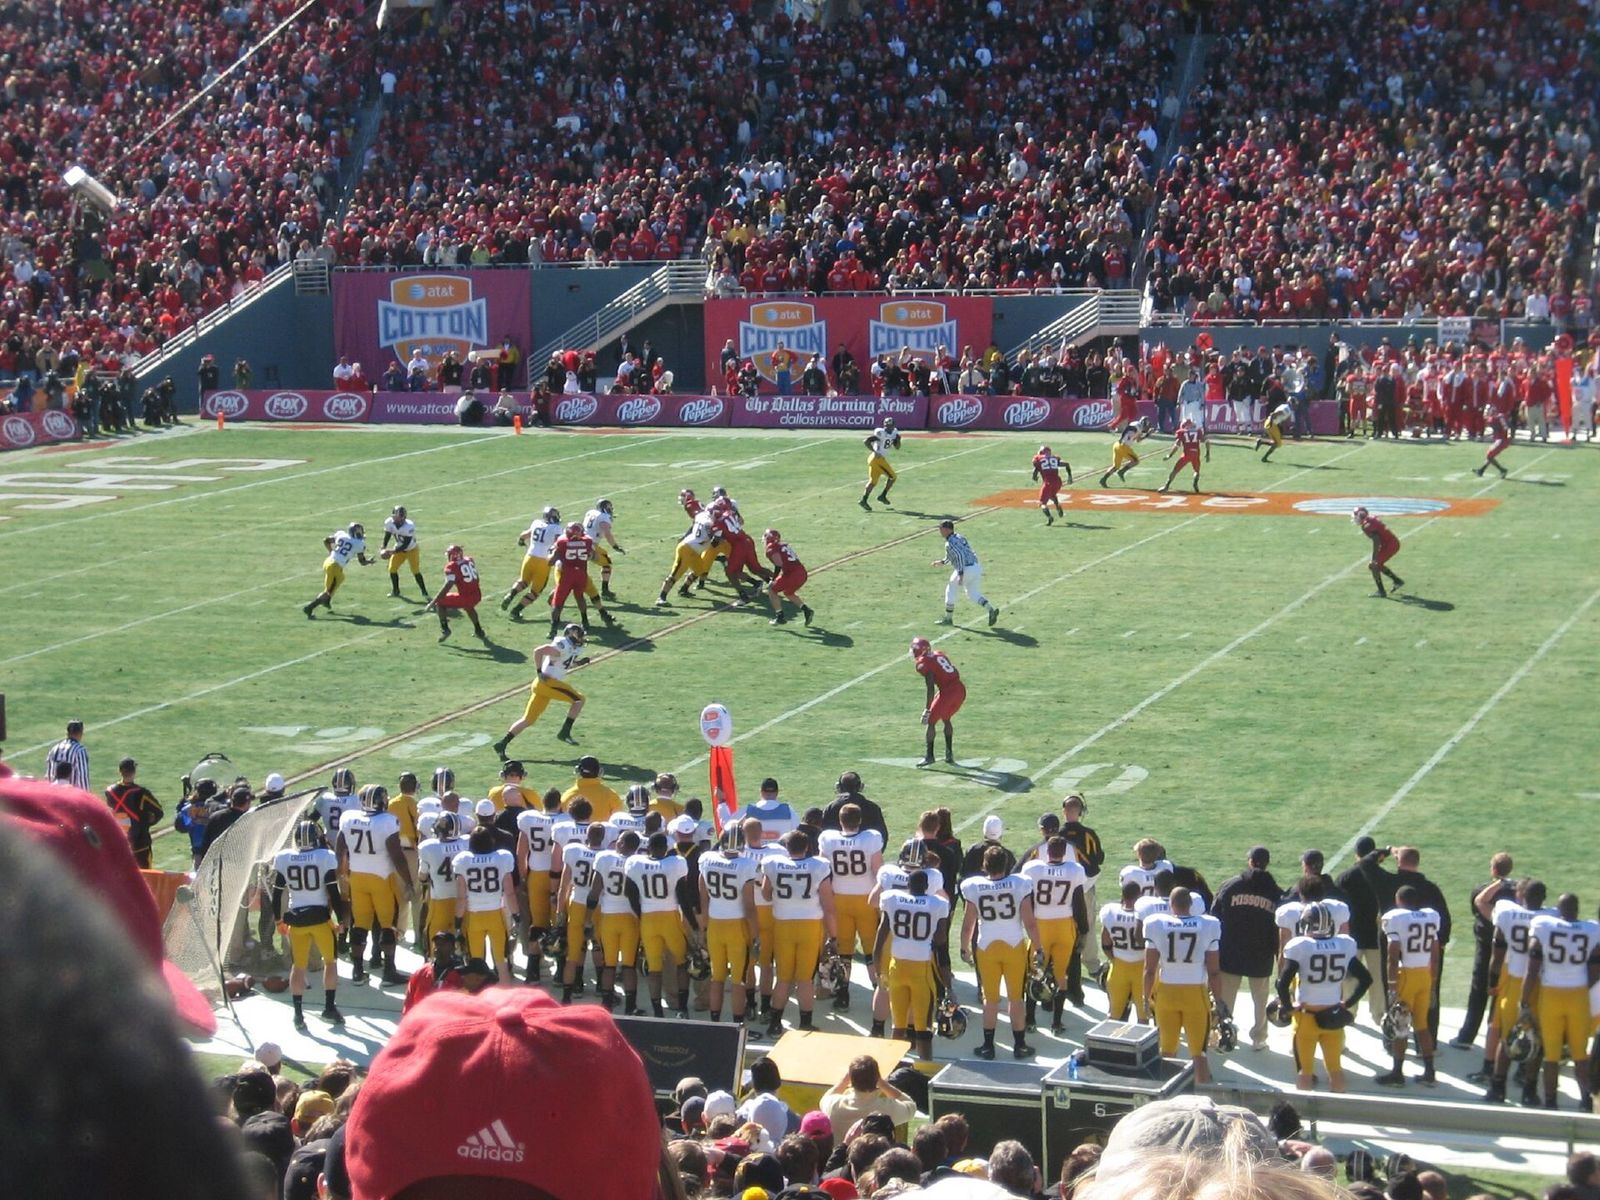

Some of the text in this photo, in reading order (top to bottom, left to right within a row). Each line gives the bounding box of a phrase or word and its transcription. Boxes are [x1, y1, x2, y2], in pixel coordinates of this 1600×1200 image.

[427, 284, 455, 298] at&t
[383, 301, 482, 341] COTTON
[780, 310, 801, 320] at&t
[909, 309, 932, 320] at&t
[743, 324, 824, 355] COTTON
[873, 323, 954, 355] COTTON
[214, 396, 240, 409] FOX
[272, 397, 299, 410] FOX
[332, 398, 357, 410] FOX
[559, 400, 593, 420] Pepper
[571, 397, 586, 410] Dr
[622, 401, 657, 421] Pepper
[632, 398, 649, 410] Dr
[684, 402, 720, 422] Pepper
[694, 398, 711, 411] Dr
[745, 397, 916, 414] The Dallas Morning News
[954, 399, 970, 411] Dr
[1021, 400, 1037, 413] Dr
[1093, 402, 1108, 414] Dr
[780, 413, 875, 425] dallasnews.com
[943, 402, 979, 424] Pepper
[1009, 403, 1047, 425] Pepper
[1184, 432, 1198, 443] 17
[1041, 458, 1058, 470] 29
[565, 549, 588, 561] 55
[350, 828, 377, 855] 71
[832, 850, 867, 876] 68
[286, 864, 320, 891] 90
[466, 866, 500, 893] 28
[641, 873, 669, 900] 10
[706, 871, 738, 901] 95
[777, 873, 812, 899] 57
[1036, 879, 1072, 906] 87
[978, 892, 1016, 921] 63
[893, 909, 931, 941] 80
[1167, 931, 1197, 963] 17
[1407, 922, 1437, 953] 26
[1549, 931, 1589, 965] 53
[1308, 954, 1346, 984] 95
[457, 1144, 524, 1162] adidas
